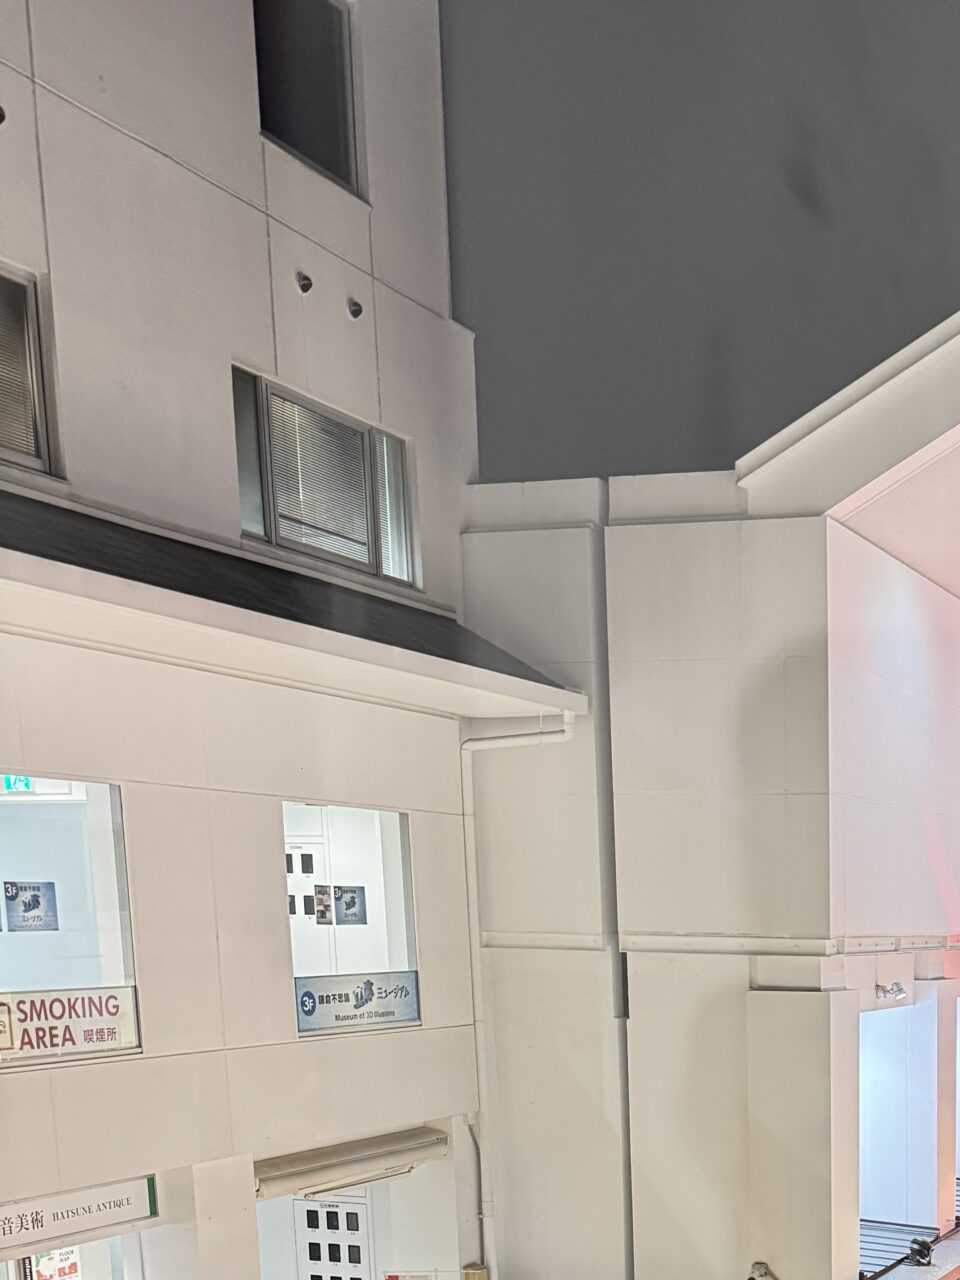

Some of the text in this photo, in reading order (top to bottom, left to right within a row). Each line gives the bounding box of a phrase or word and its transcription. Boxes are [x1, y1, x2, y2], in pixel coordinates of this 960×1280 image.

[5, 883, 18, 897] 3F
[16, 994, 120, 1024] SMOKING
[302, 995, 315, 1011] 3F
[334, 1012, 359, 1021] Museum
[19, 1024, 77, 1051] AREA
[52, 1204, 94, 1222] HATSUNE
[96, 1196, 132, 1213] ANTIQUE
